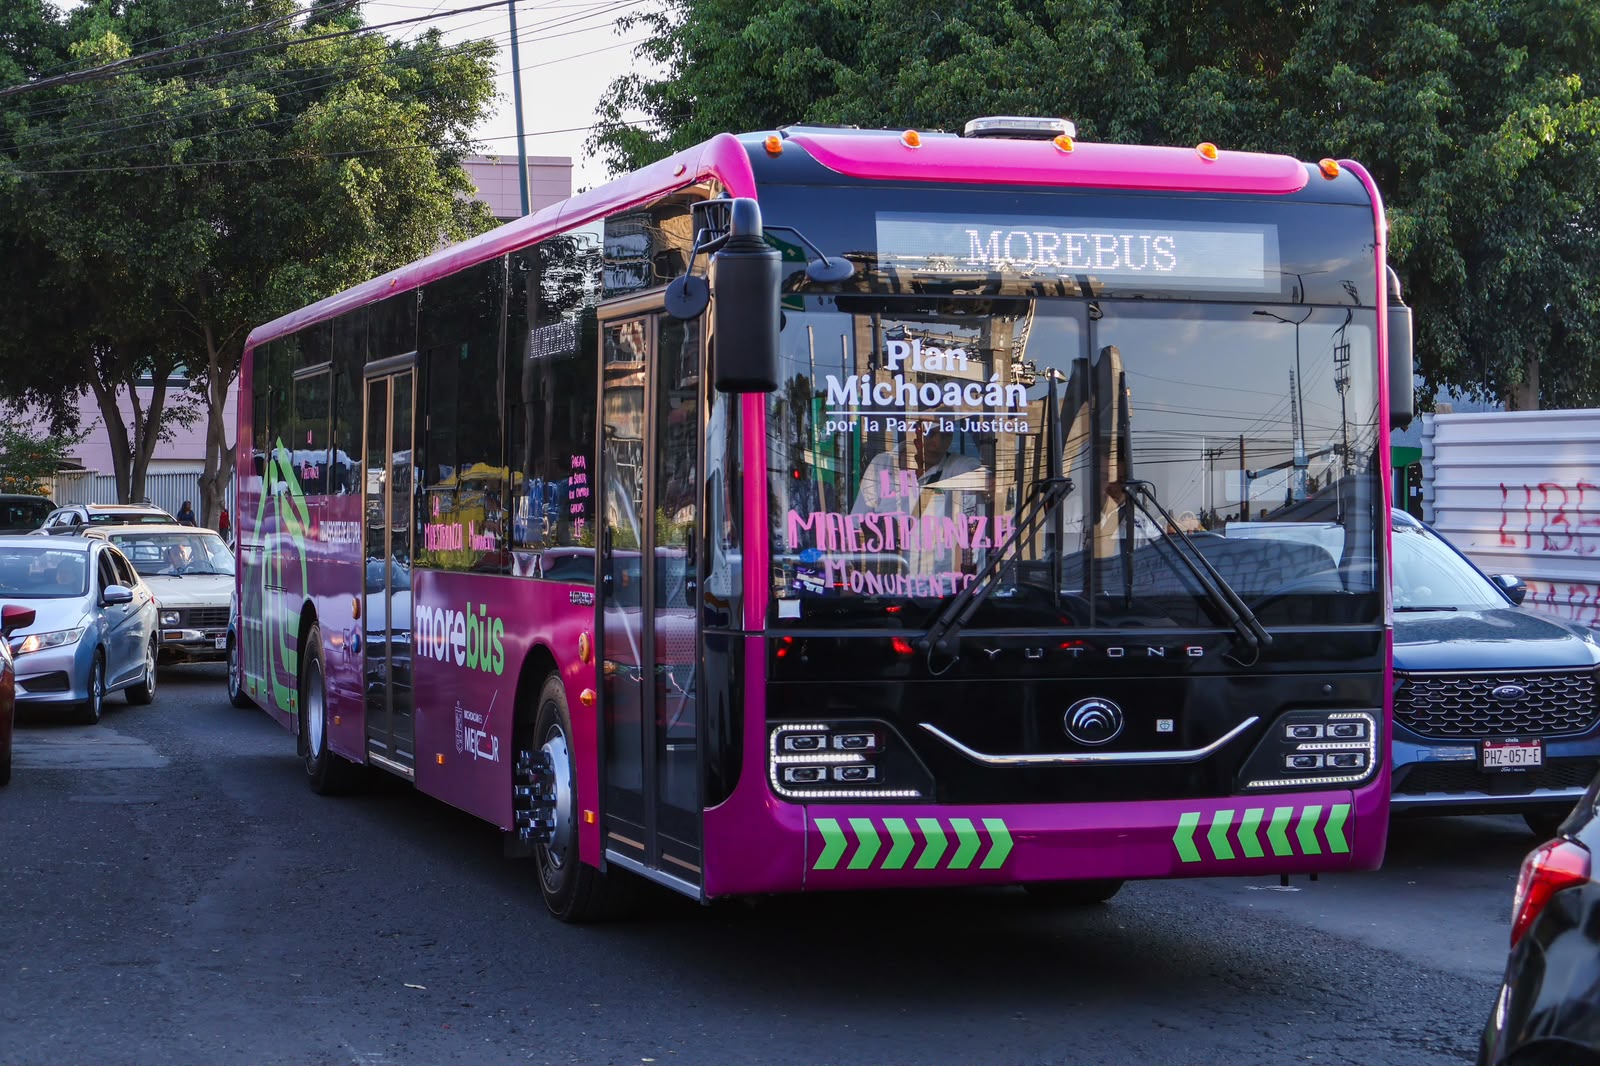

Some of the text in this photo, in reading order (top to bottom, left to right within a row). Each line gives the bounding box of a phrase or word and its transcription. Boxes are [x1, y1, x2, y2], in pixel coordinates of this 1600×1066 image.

[965, 229, 1176, 271] MOREBUS
[886, 339, 969, 371] Plan
[825, 373, 1028, 407] Michoacán
[826, 417, 1029, 436] por la Paz y la Justicia
[879, 469, 919, 499] LA
[788, 509, 1016, 560] MAESTRANZA
[984, 647, 1203, 659] YUTONG
[1484, 748, 1540, 766] PHZ-057-E
